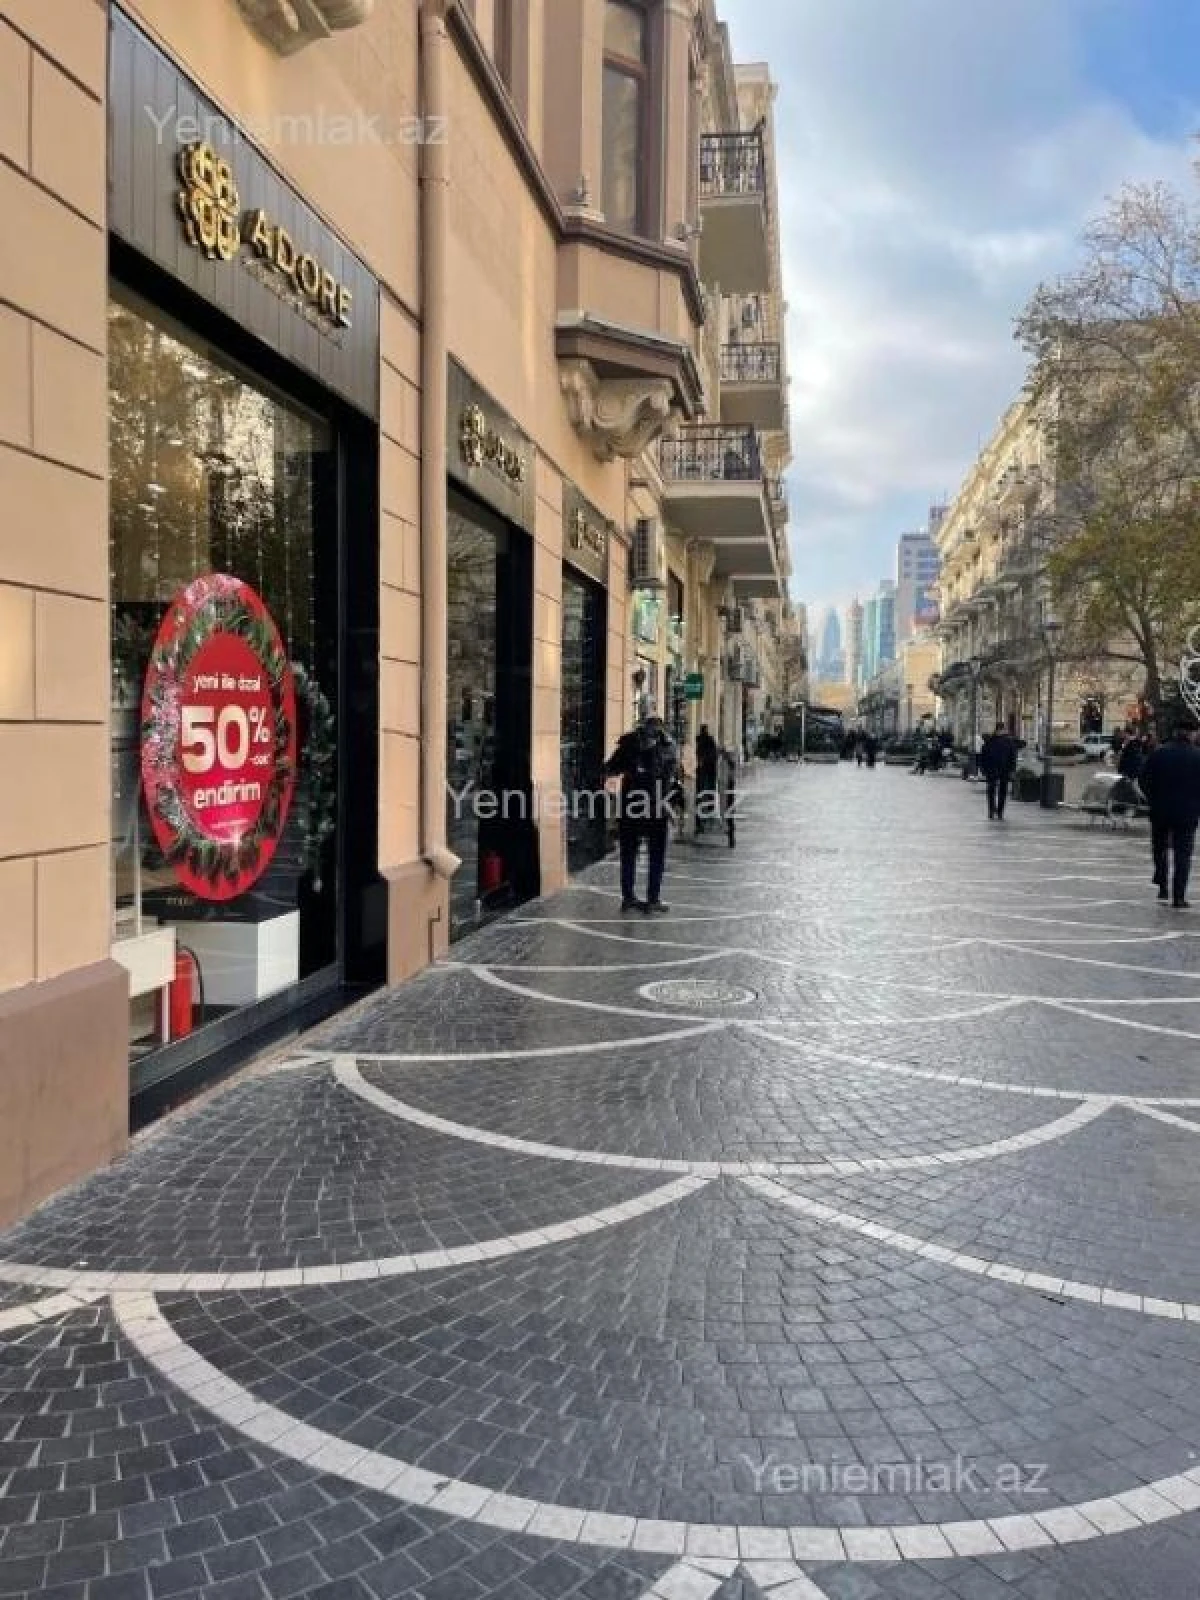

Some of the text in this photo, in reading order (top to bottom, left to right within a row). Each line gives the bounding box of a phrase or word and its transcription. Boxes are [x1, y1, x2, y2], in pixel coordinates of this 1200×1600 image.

[244, 208, 352, 328] ADORE
[181, 703, 270, 773] 50%
[193, 778, 261, 808] endirim
